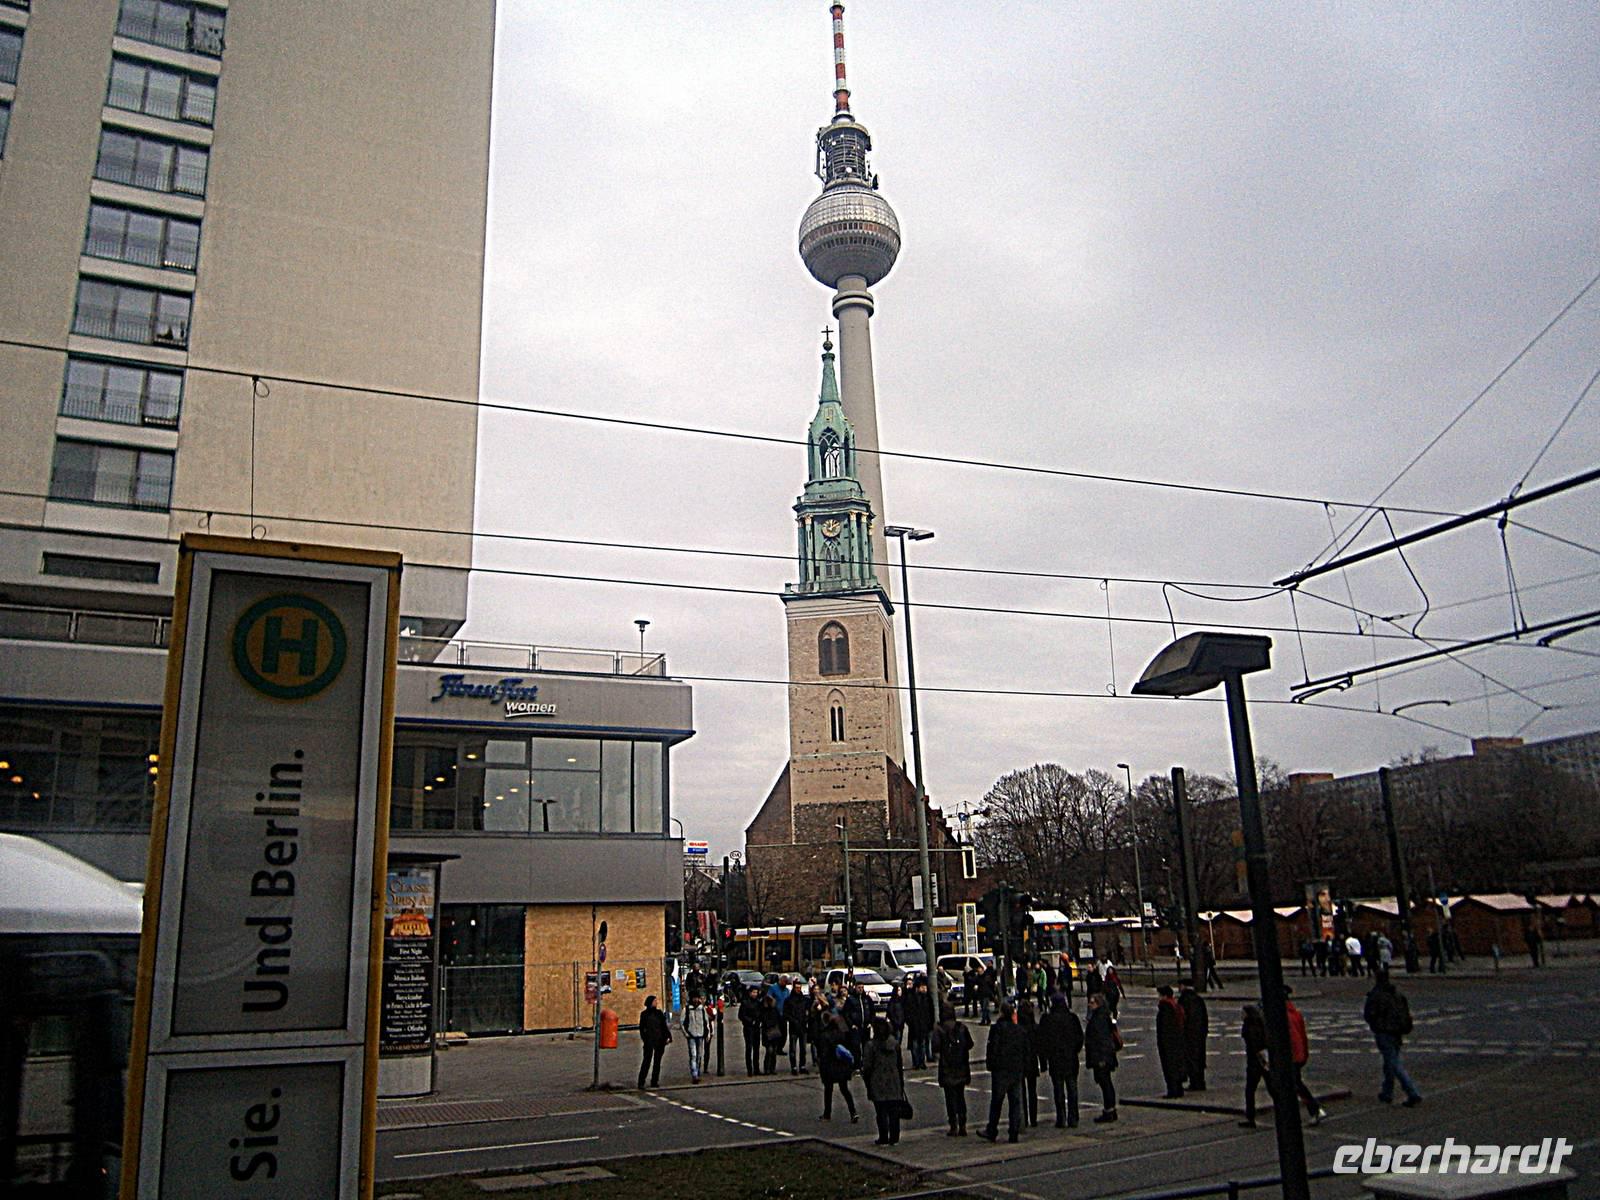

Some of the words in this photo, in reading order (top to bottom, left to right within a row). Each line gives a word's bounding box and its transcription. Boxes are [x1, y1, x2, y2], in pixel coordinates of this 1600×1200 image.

[261, 616, 318, 677] H
[505, 701, 557, 713] women
[251, 747, 305, 899] Berlin.
[242, 908, 293, 1014] Und
[231, 1086, 282, 1182] Sie.
